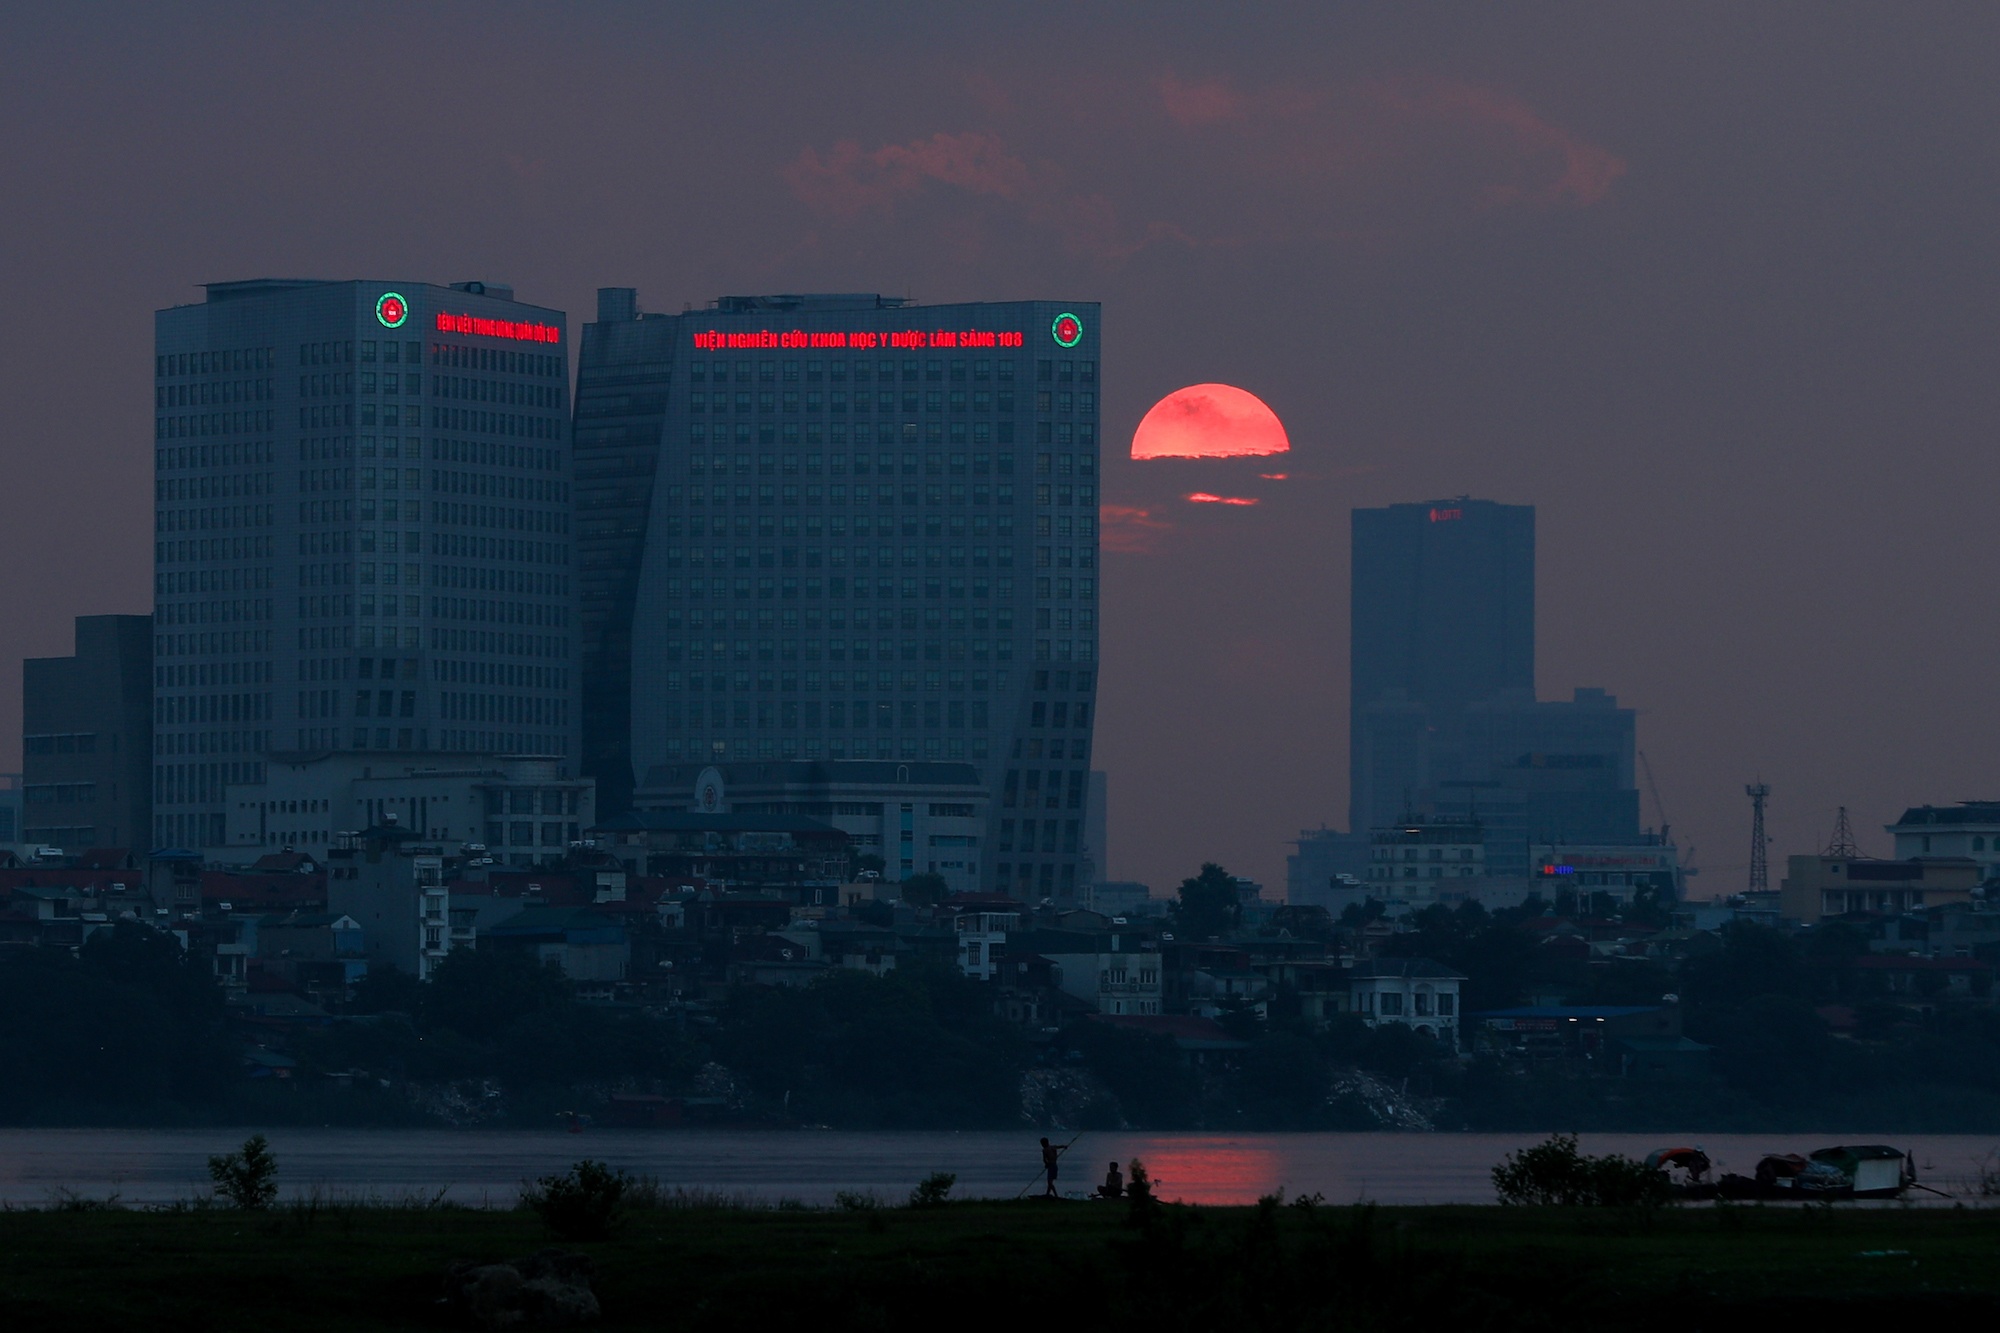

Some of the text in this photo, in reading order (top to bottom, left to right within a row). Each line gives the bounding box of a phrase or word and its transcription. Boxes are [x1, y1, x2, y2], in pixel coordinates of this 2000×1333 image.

[457, 313, 473, 336] VIỆN
[694, 330, 726, 351] VIỆN
[728, 330, 778, 348] NGHIÊN
[781, 330, 808, 348] CỨU
[811, 332, 846, 348] KHOA
[849, 332, 878, 350] HỌC
[879, 333, 888, 347] Y
[929, 330, 958, 347] LÂM
[997, 332, 1023, 347] 108
[1438, 509, 1461, 520] LOTTE
